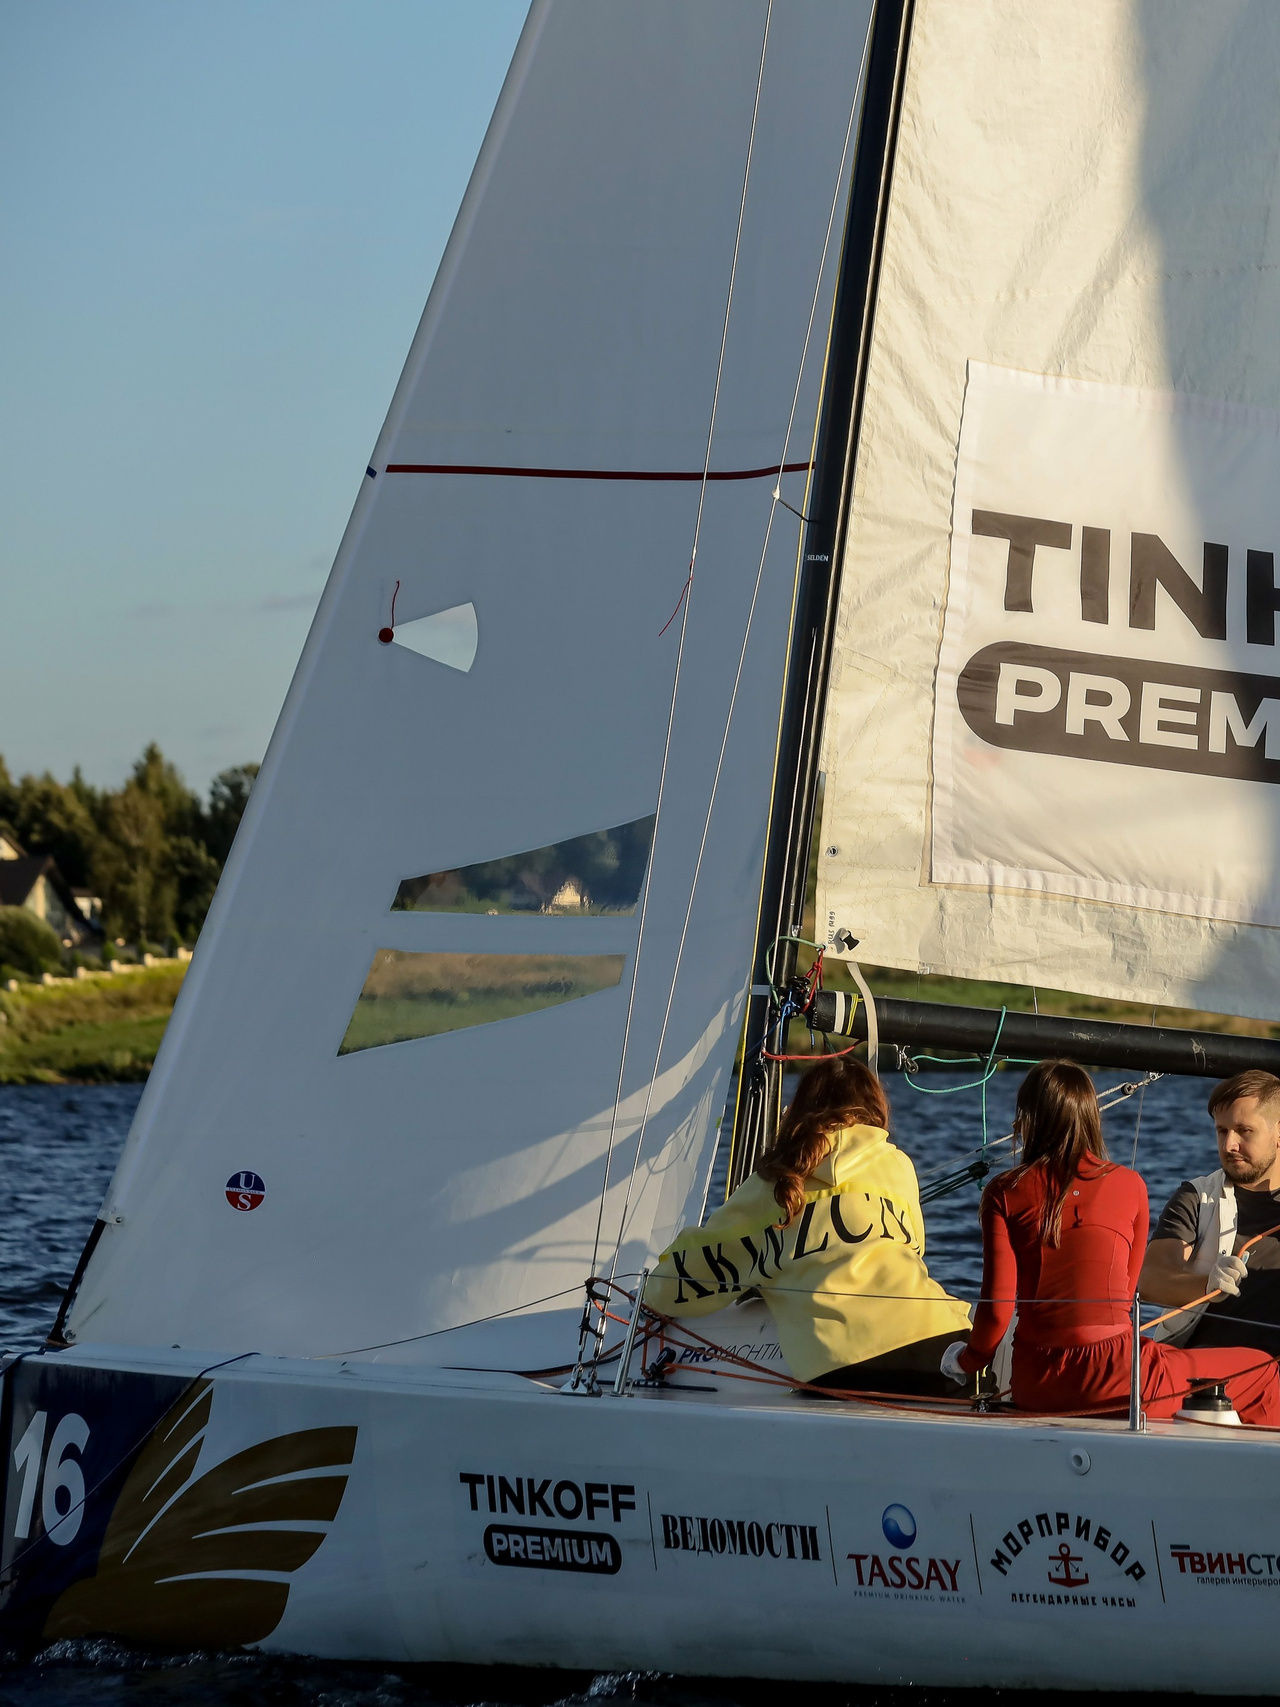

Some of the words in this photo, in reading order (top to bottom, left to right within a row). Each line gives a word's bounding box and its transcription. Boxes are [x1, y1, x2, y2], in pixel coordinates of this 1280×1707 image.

[14, 1410, 91, 1546] 16
[459, 1472, 637, 1523] TINKOFF
[491, 1532, 613, 1567] PREMIUM
[660, 1513, 822, 1562] ВЕДОМОСТИ
[990, 1512, 1147, 1582] МОРПРИБОР
[846, 1553, 962, 1592] TASSAY
[1102, 1596, 1137, 1608] ЧАСЫ
